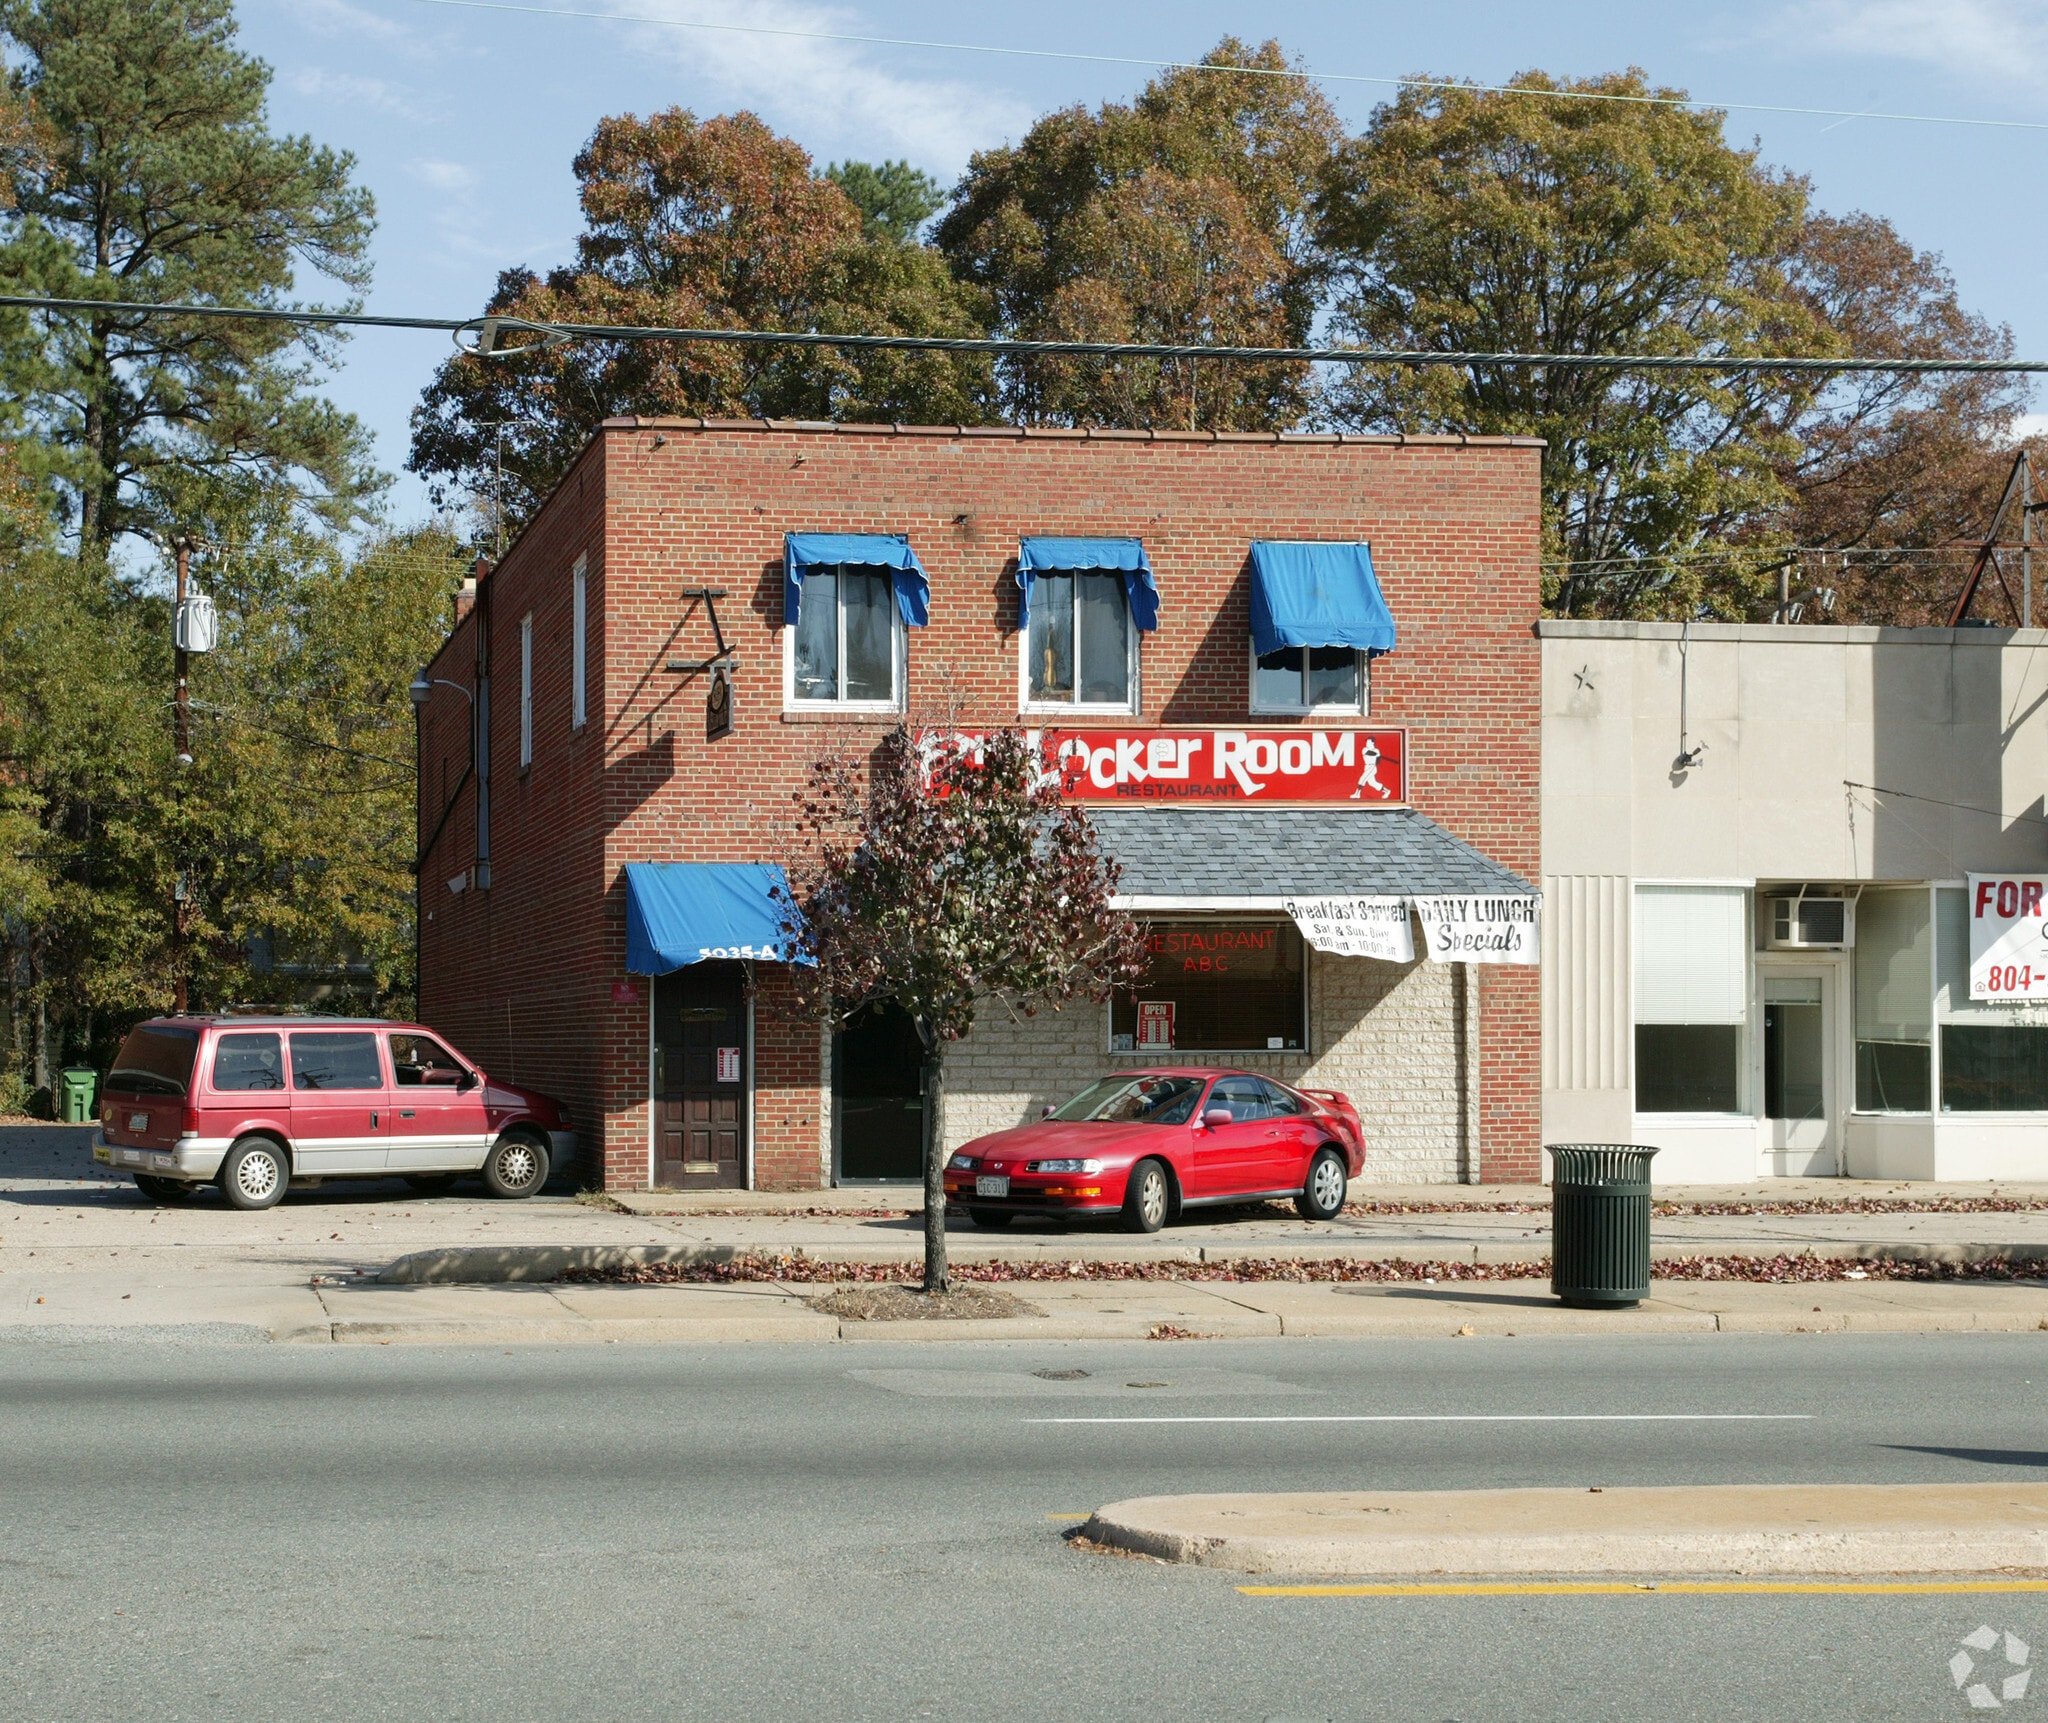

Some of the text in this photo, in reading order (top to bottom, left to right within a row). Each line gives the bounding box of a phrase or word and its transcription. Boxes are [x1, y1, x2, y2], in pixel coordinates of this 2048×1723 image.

[1116, 783, 1239, 797] RESTAURANT
[1975, 881, 2043, 918] FOR
[1287, 900, 1407, 922] Breakfast Served
[1421, 899, 1536, 922] DAILY LUNCH
[1336, 926, 1344, 937] &
[1346, 925, 1368, 938] Sun.
[1437, 923, 1522, 952] Specials
[1139, 930, 1275, 953] RESTAURANT
[1335, 940, 1349, 952] am
[699, 945, 777, 961] 5035-A
[1145, 1004, 1167, 1015] OPEN
